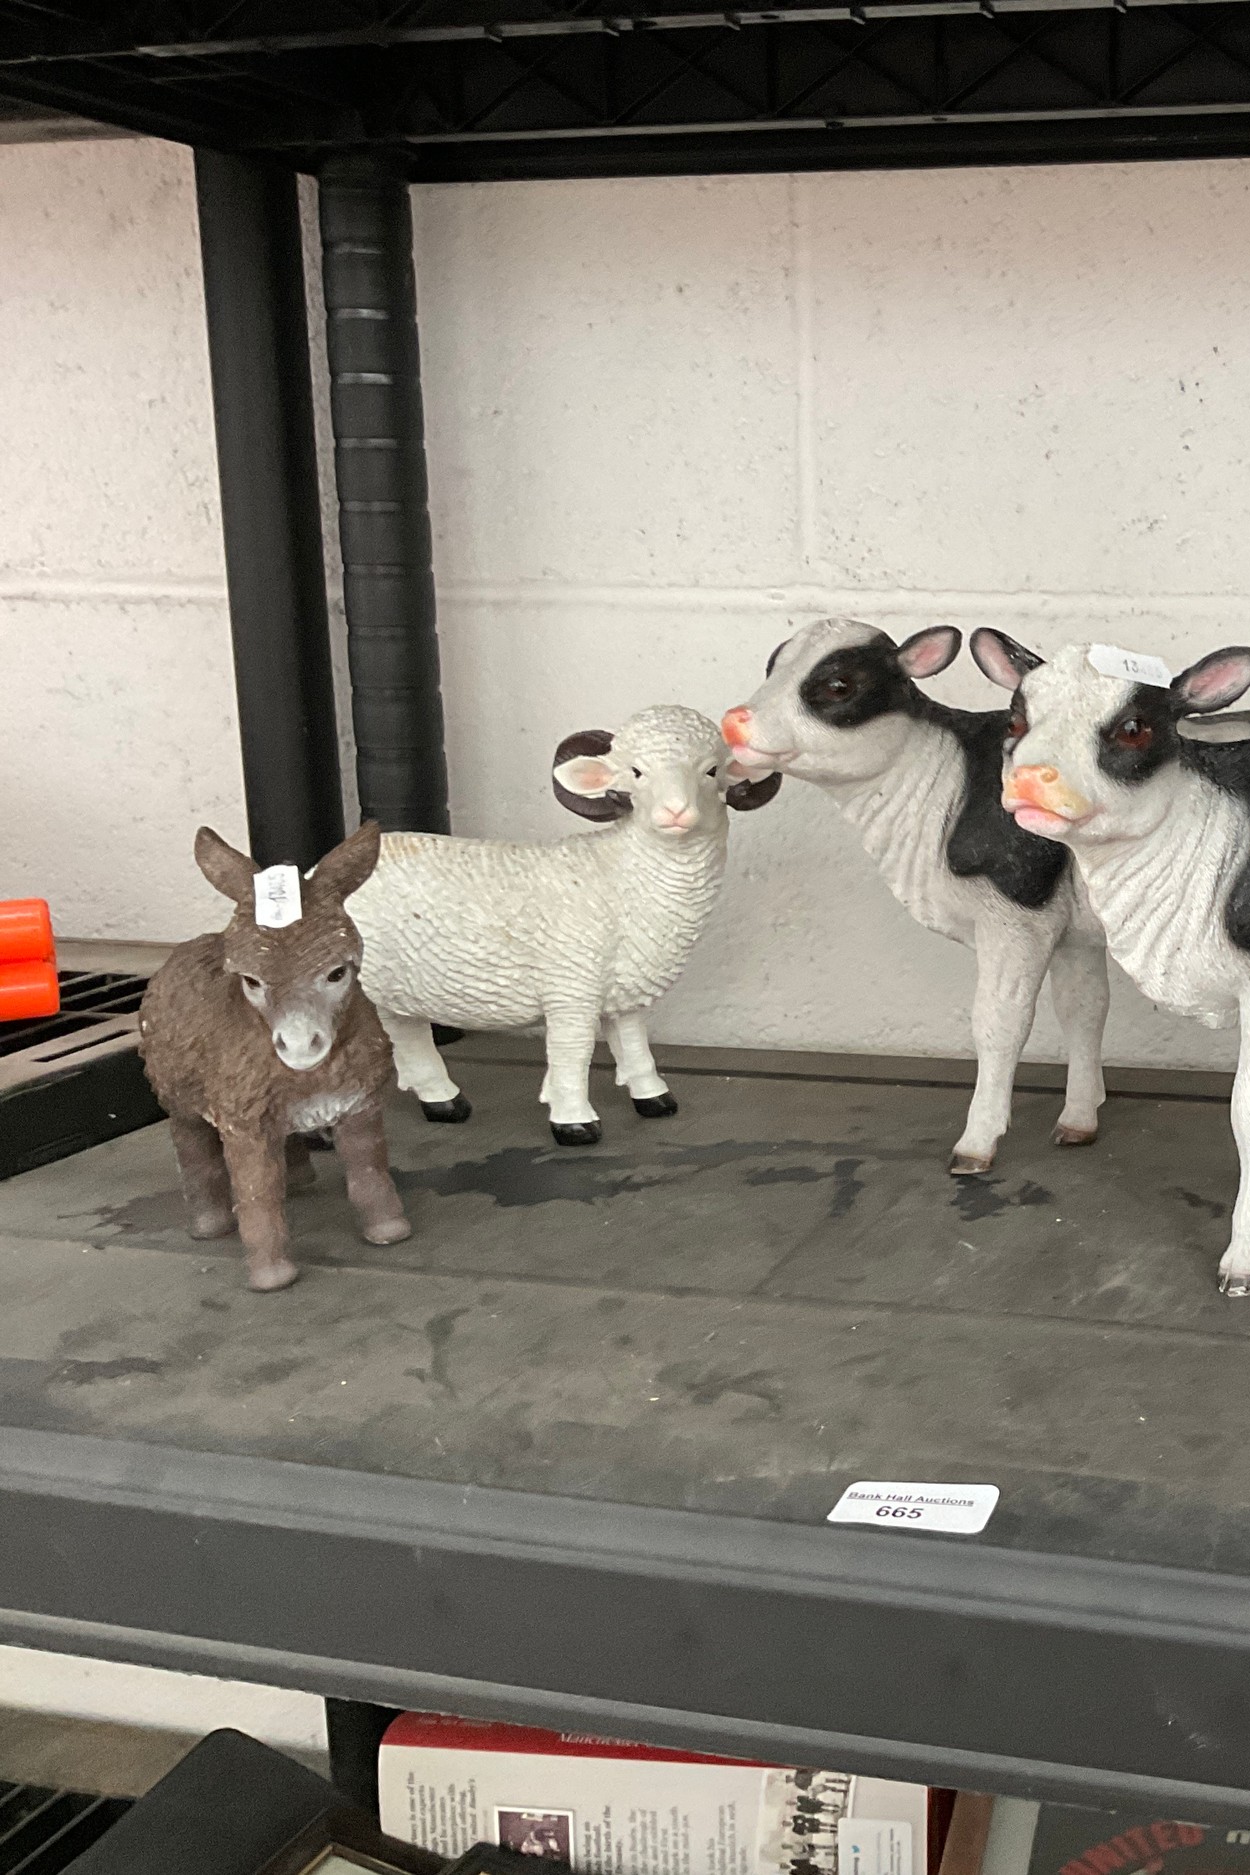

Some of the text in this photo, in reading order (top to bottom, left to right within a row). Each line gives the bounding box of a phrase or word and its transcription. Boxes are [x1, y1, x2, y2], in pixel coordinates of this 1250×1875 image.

[847, 1491, 975, 1507] Bank Hall Auctions
[875, 1505, 924, 1520] 665
